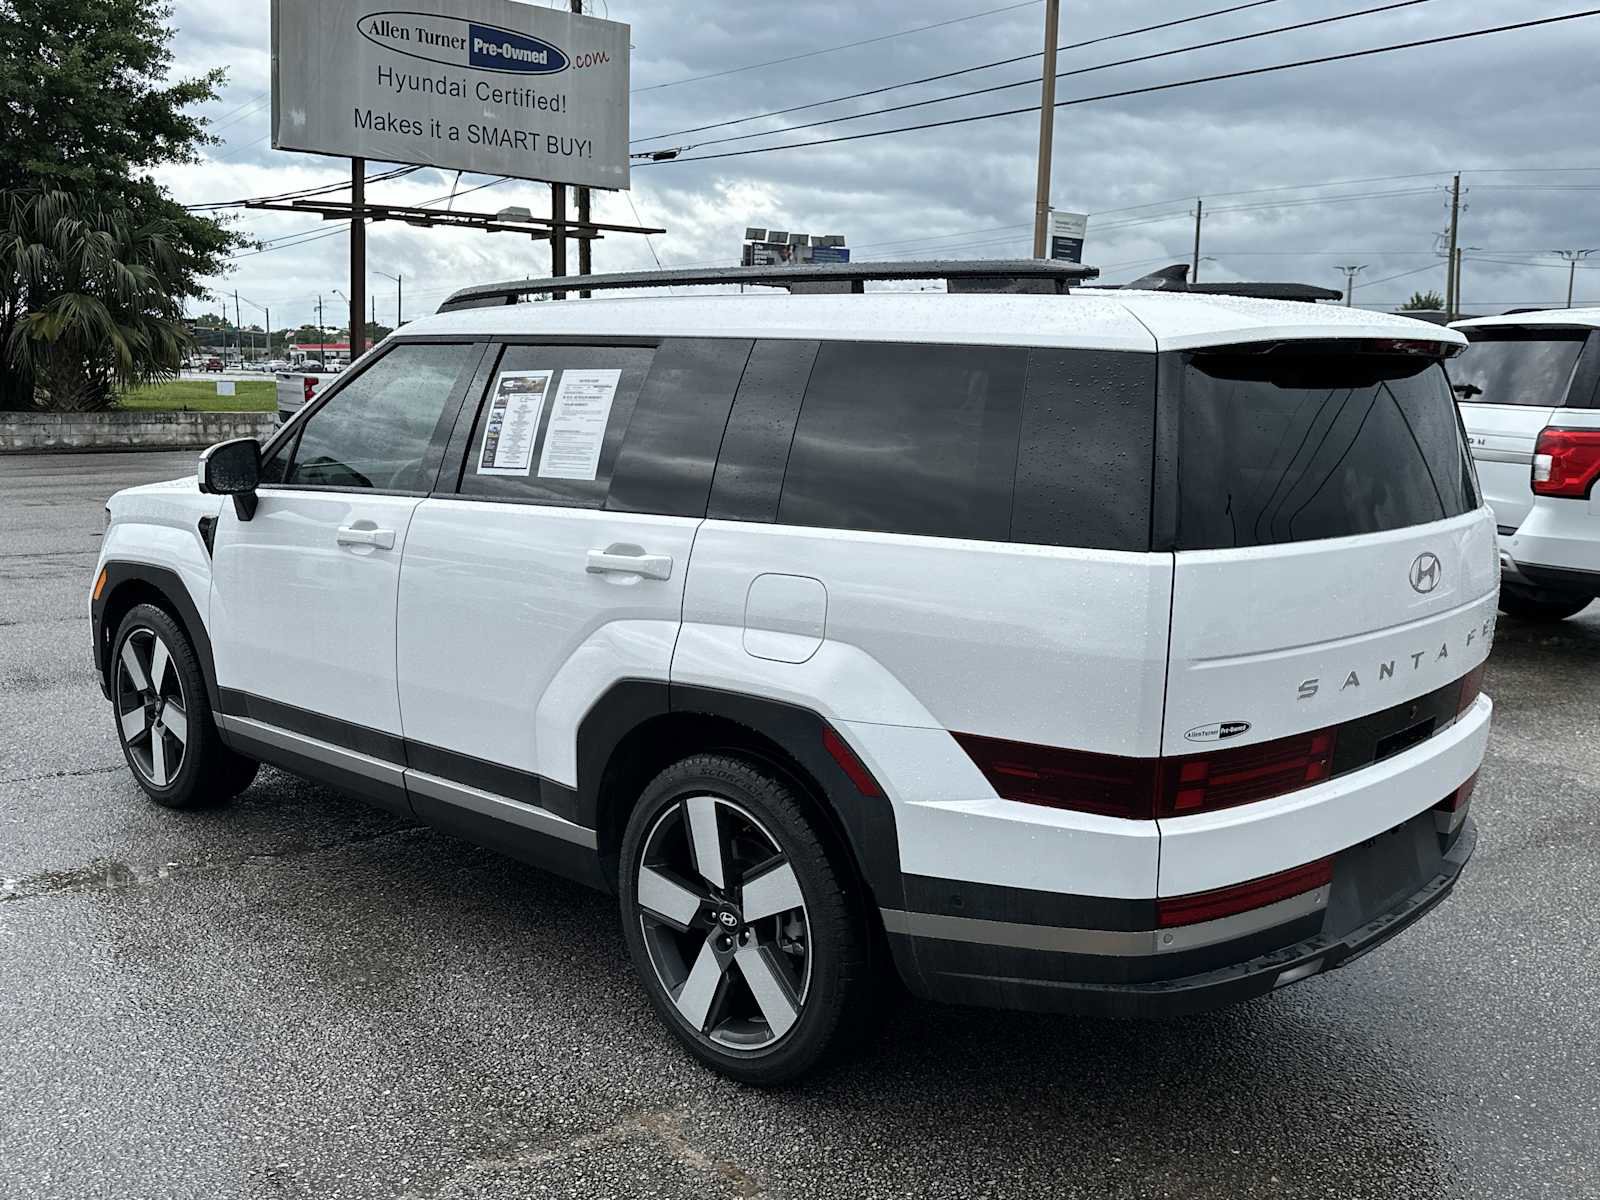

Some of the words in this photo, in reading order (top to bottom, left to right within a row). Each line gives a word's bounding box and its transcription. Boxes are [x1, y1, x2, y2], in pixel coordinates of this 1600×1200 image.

[369, 20, 410, 41] Allen
[415, 27, 467, 50] Turner
[473, 37, 548, 65] Pre-Owned
[377, 65, 467, 98] Hyundai
[475, 81, 567, 113] Certified!
[354, 108, 423, 136] Makes
[430, 118, 442, 139] it
[448, 126, 460, 141] a
[467, 124, 540, 152] SMART
[547, 135, 593, 158] BUY!
[1297, 642, 1449, 701] SANTA
